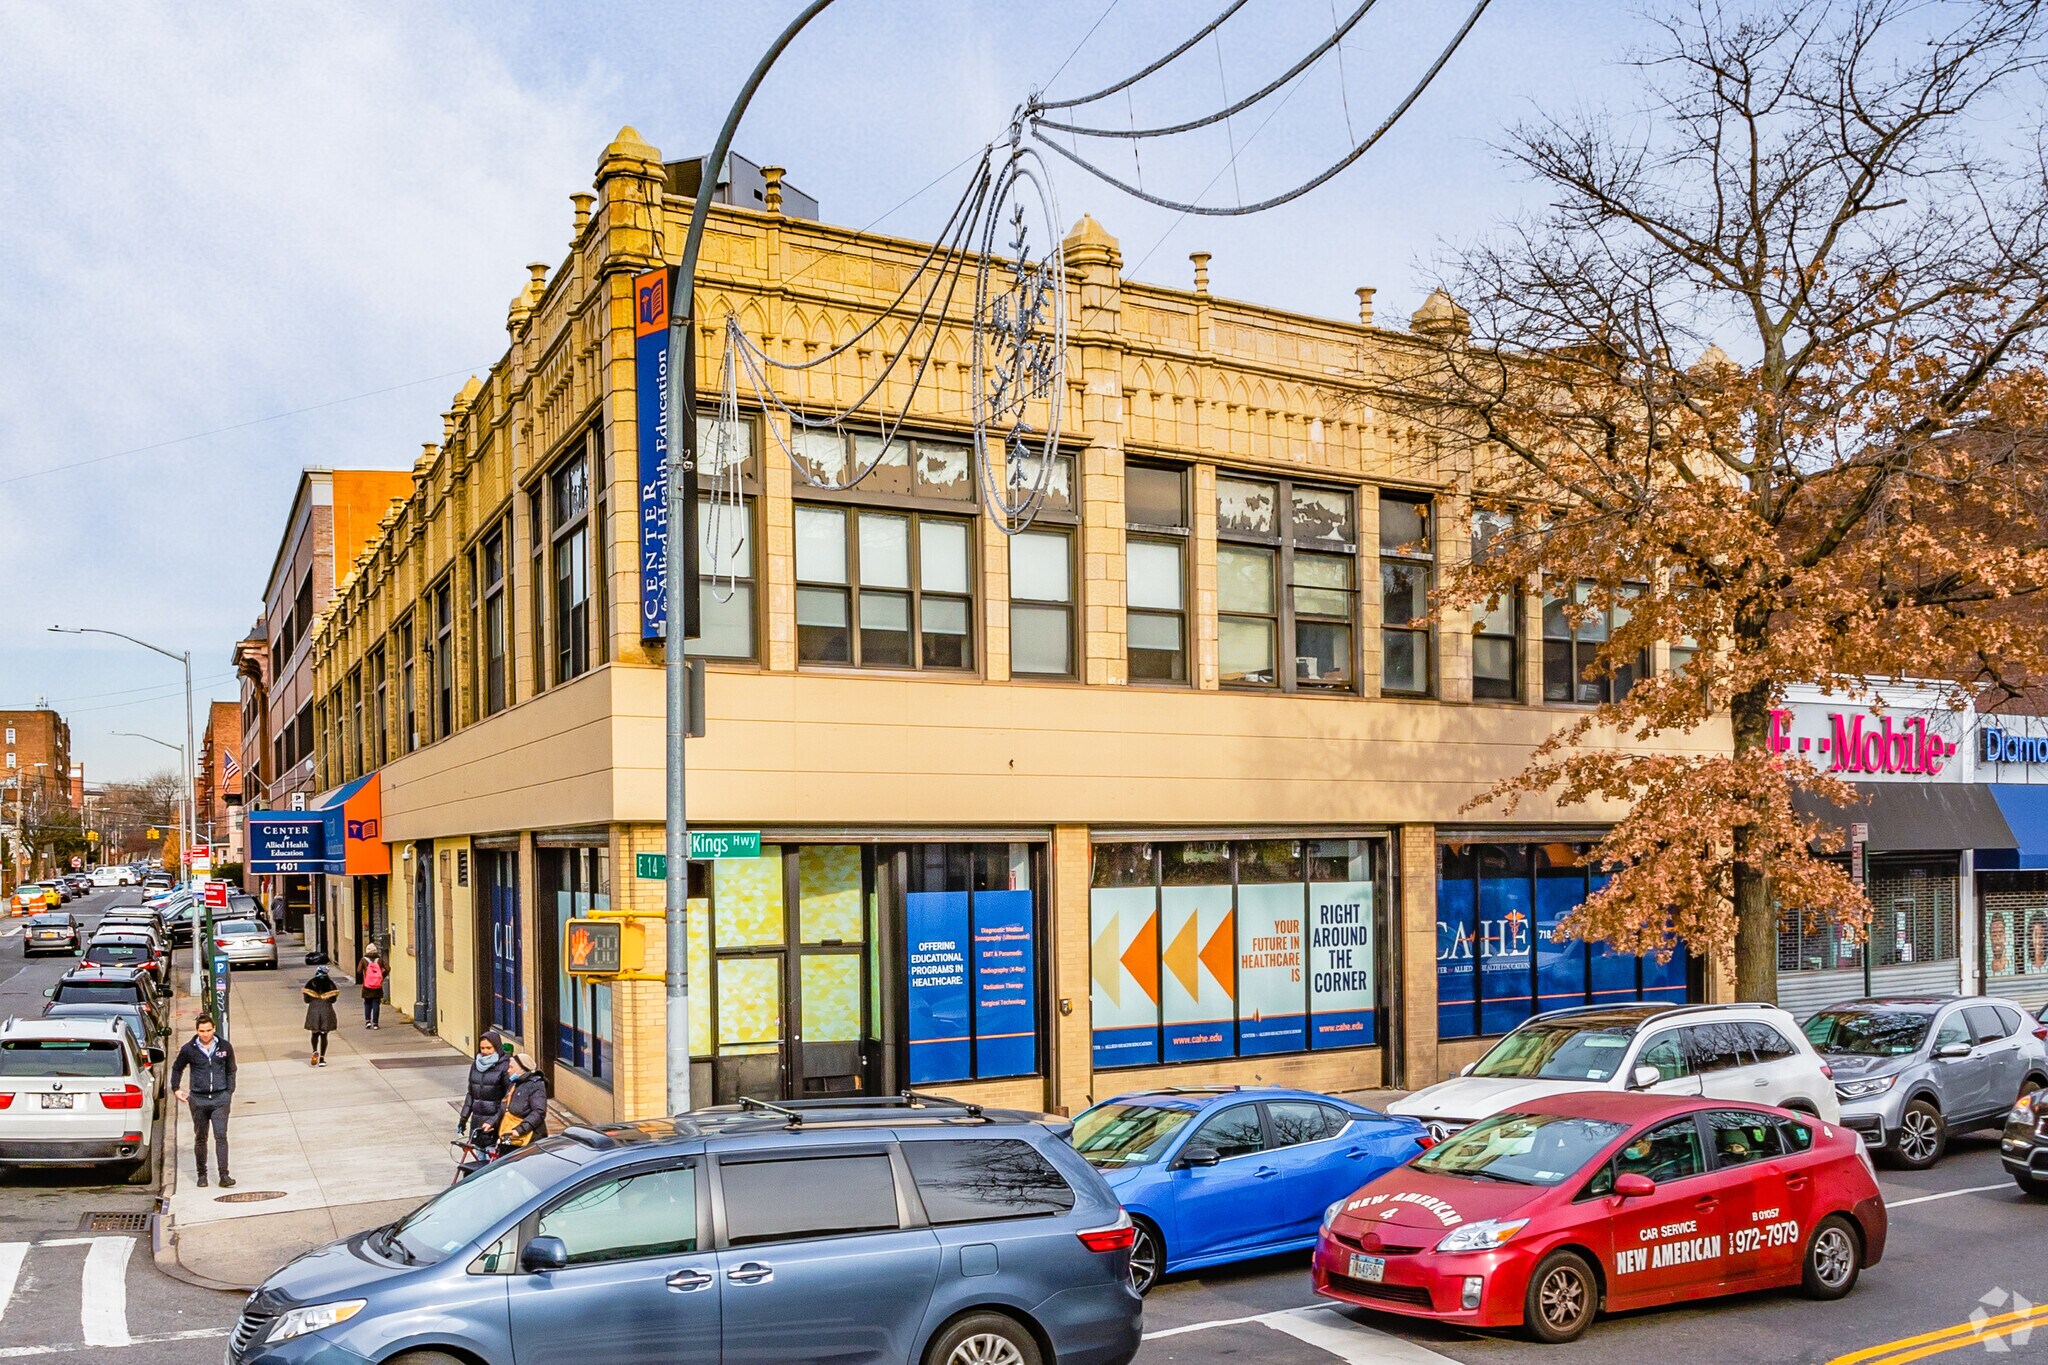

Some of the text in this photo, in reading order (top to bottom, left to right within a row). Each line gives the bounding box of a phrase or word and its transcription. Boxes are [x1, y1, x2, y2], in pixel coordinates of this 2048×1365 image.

[656, 348, 668, 453] Education
[643, 480, 658, 620] CENTER
[263, 826, 310, 835] CENTER
[265, 840, 309, 849] Allied Health
[692, 833, 756, 858] Kings Hwy
[270, 849, 304, 857] Education
[275, 862, 298, 871] 1401
[638, 856, 643, 876] E
[647, 857, 658, 877] 14
[1320, 904, 1360, 925] RIGHT
[1274, 919, 1299, 934] YOUR
[1252, 936, 1300, 952] FUTURE IN
[1313, 926, 1367, 948] AROUND
[1437, 919, 1531, 960] CAHE
[918, 941, 956, 951] OFFERING
[911, 952, 963, 964] EDUCATIONAL
[1241, 952, 1300, 969] HEALTHCARE
[1328, 949, 1353, 969] THE
[911, 964, 964, 975] PROGRAMS IN
[1291, 968, 1301, 982] IS
[912, 975, 963, 987] HEALTHCARE:
[1314, 970, 1367, 993] CORNER
[1318, 1021, 1364, 1033] www.cahe.edu
[1172, 1034, 1223, 1046] www.cahe.edu
[1823, 1125, 1834, 1138] 4
[1347, 1192, 1463, 1227] NEW AMERICAN
[1379, 1207, 1399, 1220] 4
[1752, 1208, 1780, 1222] B 01057
[1639, 1220, 1697, 1242] CAR SERVICE
[1735, 1220, 1799, 1254] 972-7979
[1616, 1235, 1721, 1275] NEW AMERICAN
